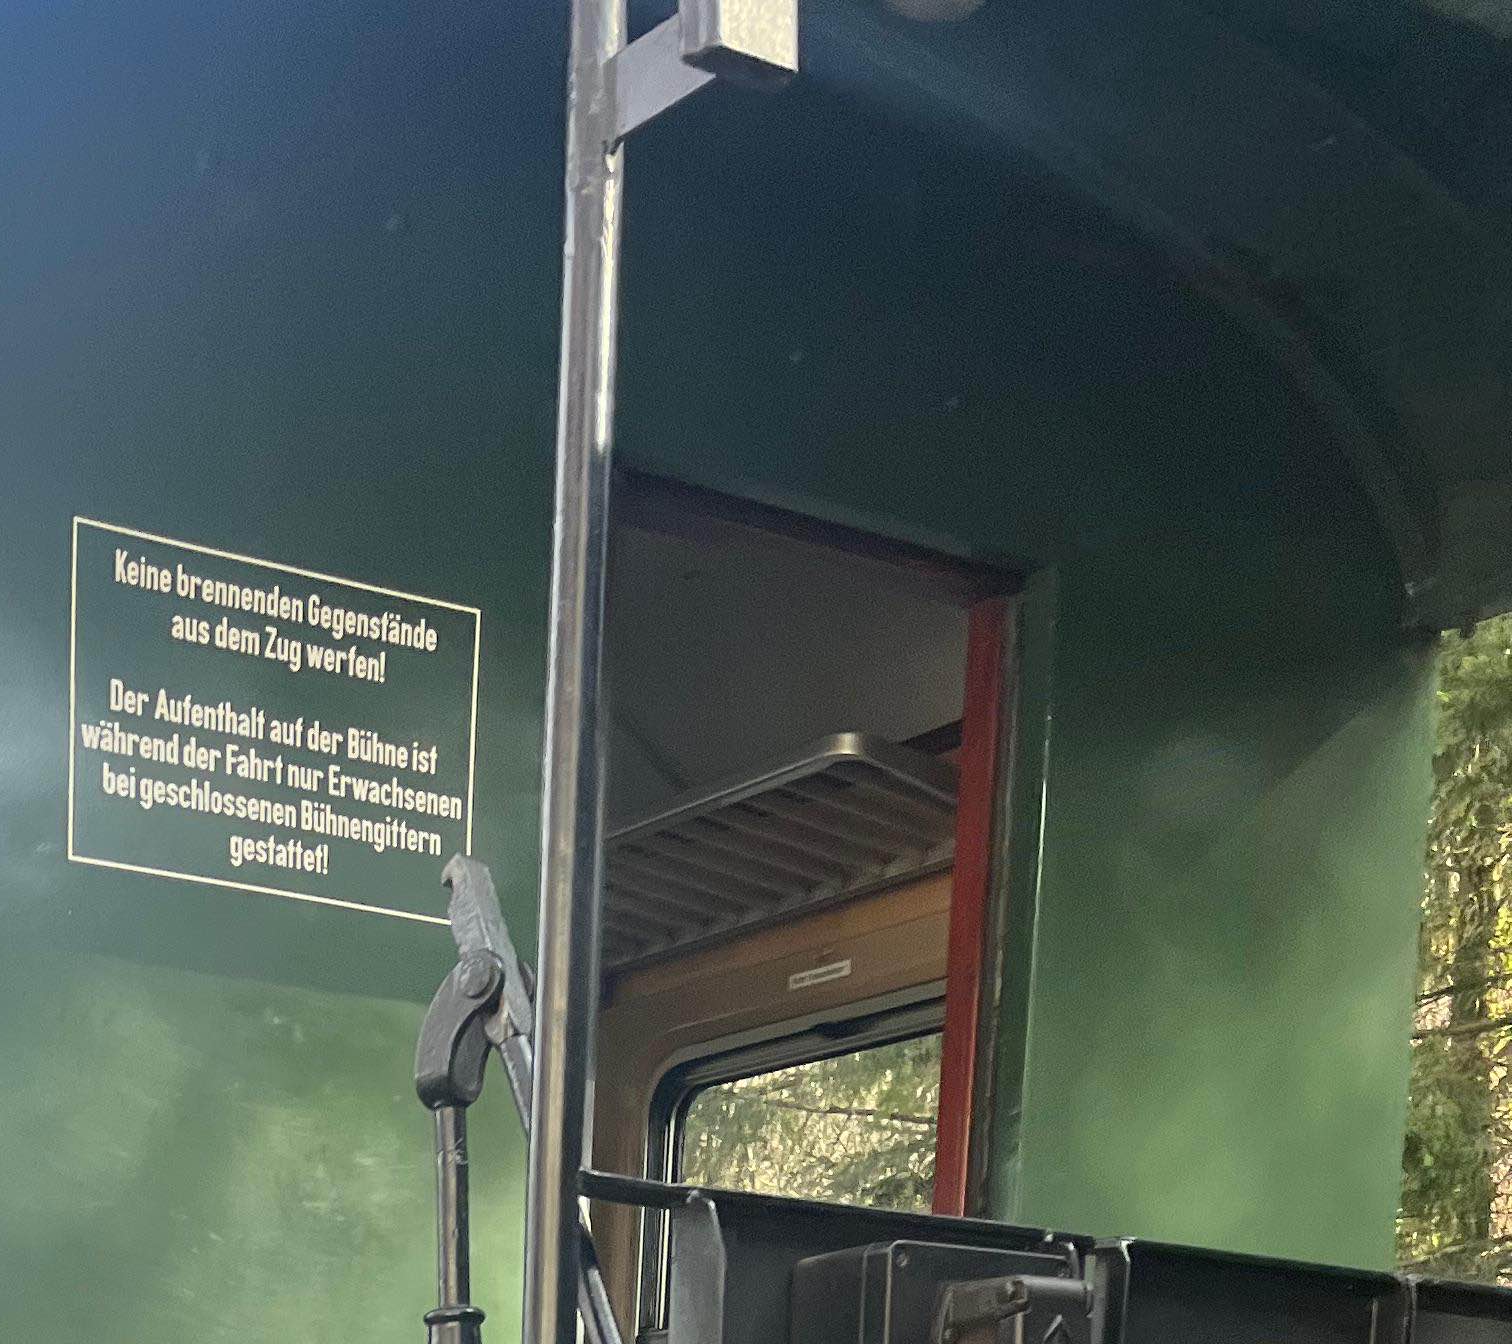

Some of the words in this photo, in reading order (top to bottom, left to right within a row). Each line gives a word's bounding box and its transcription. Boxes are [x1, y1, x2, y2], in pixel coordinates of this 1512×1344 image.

[115, 548, 171, 593] Keine
[177, 564, 303, 622] brennenden
[308, 594, 438, 651] Gegenstände
[172, 613, 210, 644] aus
[216, 617, 259, 656] dem
[265, 626, 301, 672] Zug
[307, 644, 386, 683] werfen!
[81, 720, 178, 767] während
[183, 737, 221, 771] der
[226, 744, 283, 784] Fahrt
[288, 762, 324, 792] nur
[328, 765, 462, 820] Erwachsenen
[110, 679, 149, 716] Der
[155, 689, 265, 740] Aufenthalt
[270, 717, 304, 746] auf
[307, 721, 343, 755] der
[347, 728, 407, 769] Bühne
[413, 742, 437, 774] ist
[103, 762, 135, 798] bei
[140, 779, 296, 829] geschlossenen
[301, 800, 441, 856] Bühnengittern
[230, 834, 328, 875] gestattet!
